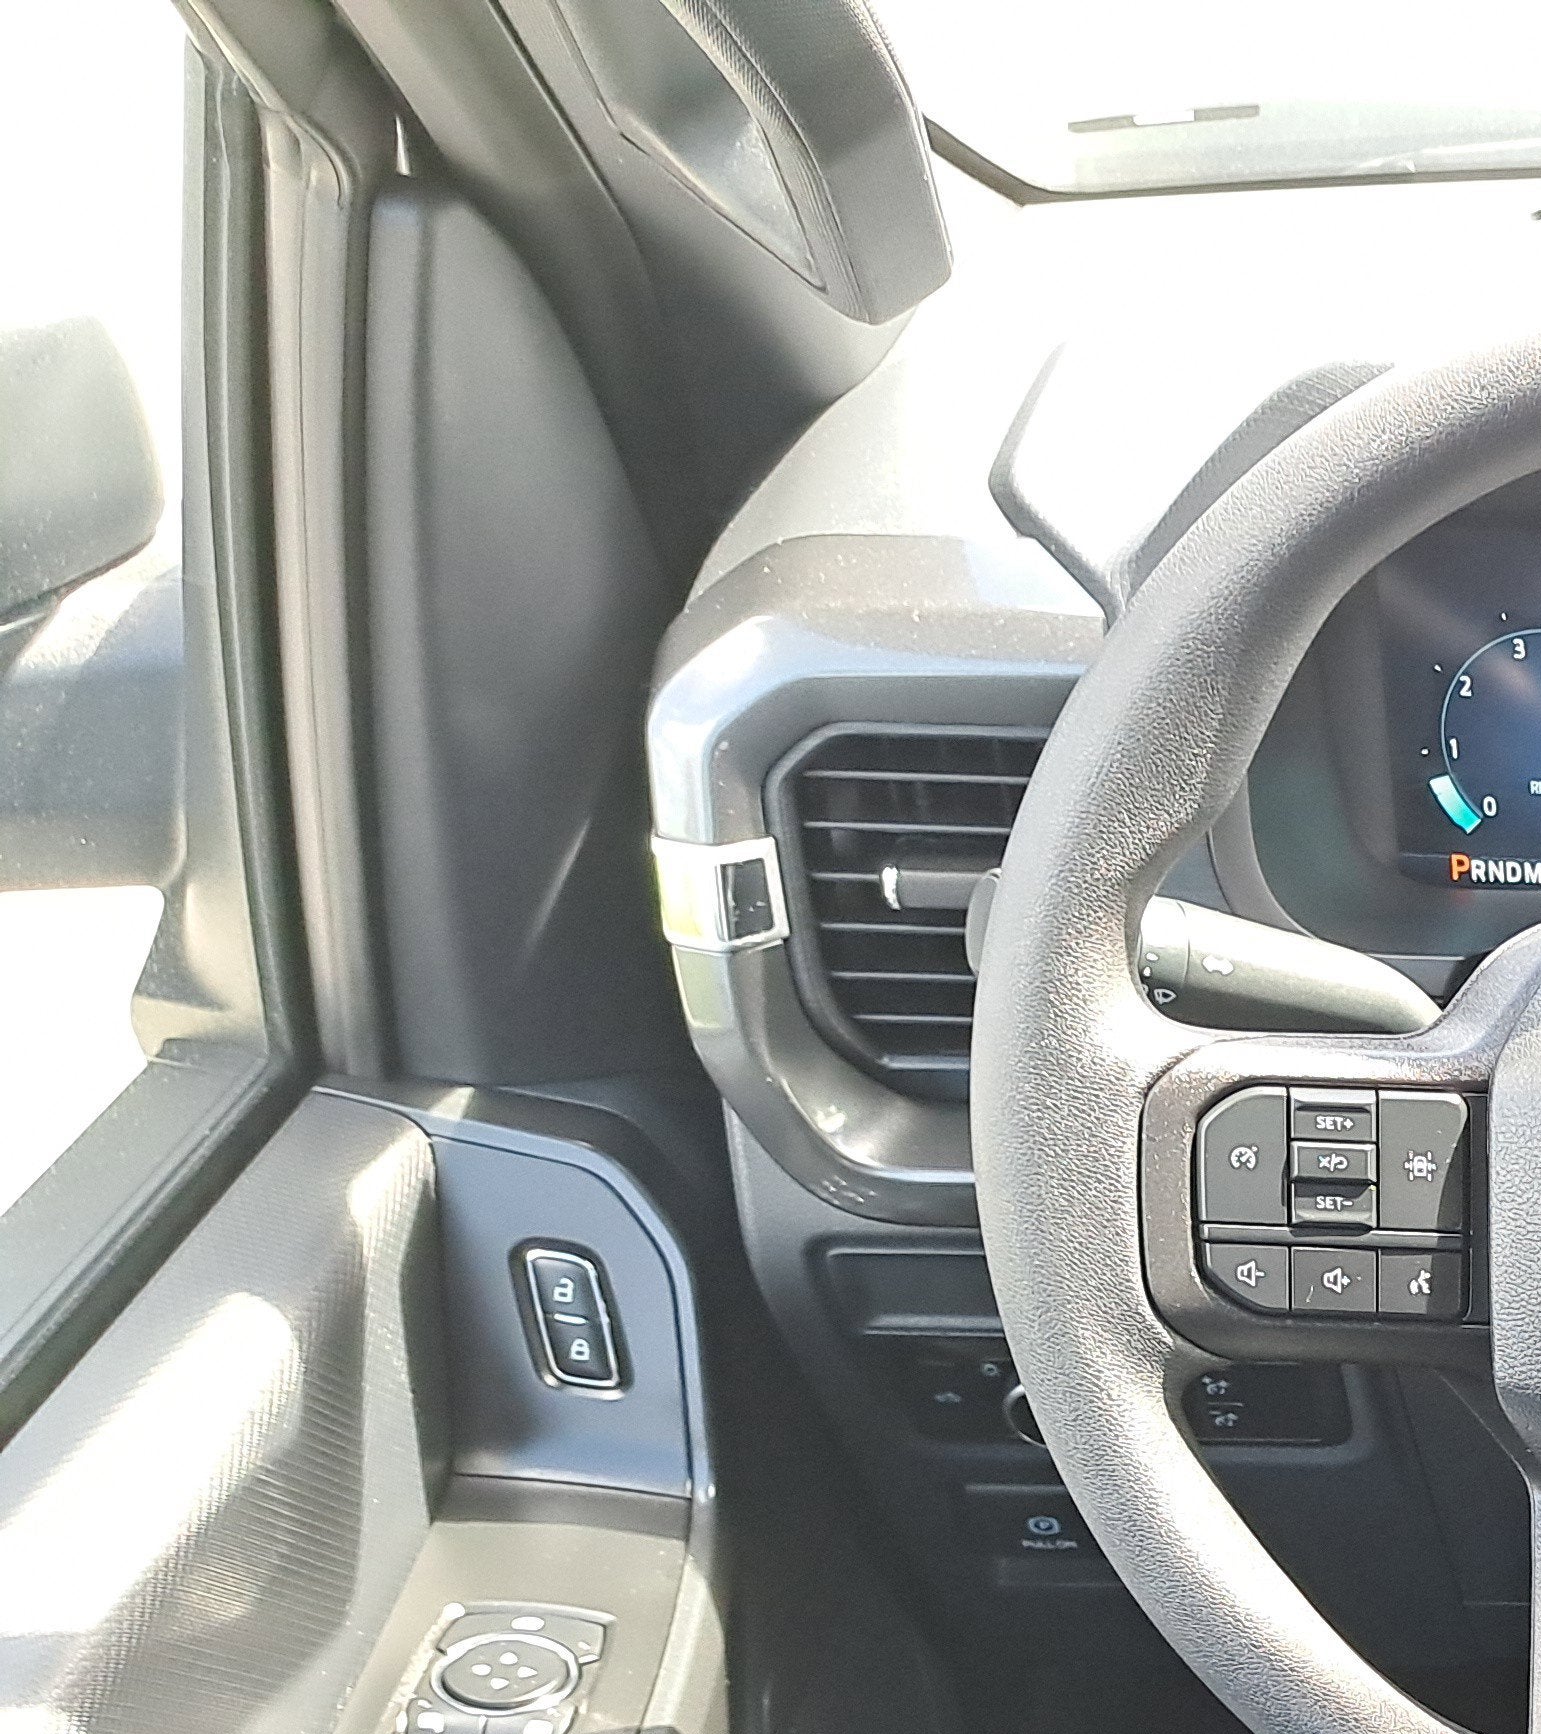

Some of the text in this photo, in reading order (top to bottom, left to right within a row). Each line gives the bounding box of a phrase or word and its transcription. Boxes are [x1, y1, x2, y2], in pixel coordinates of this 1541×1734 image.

[1512, 638, 1526, 660] 3
[1459, 675, 1473, 697] 2
[1450, 738, 1459, 759] 1
[1483, 796, 1497, 817] 0
